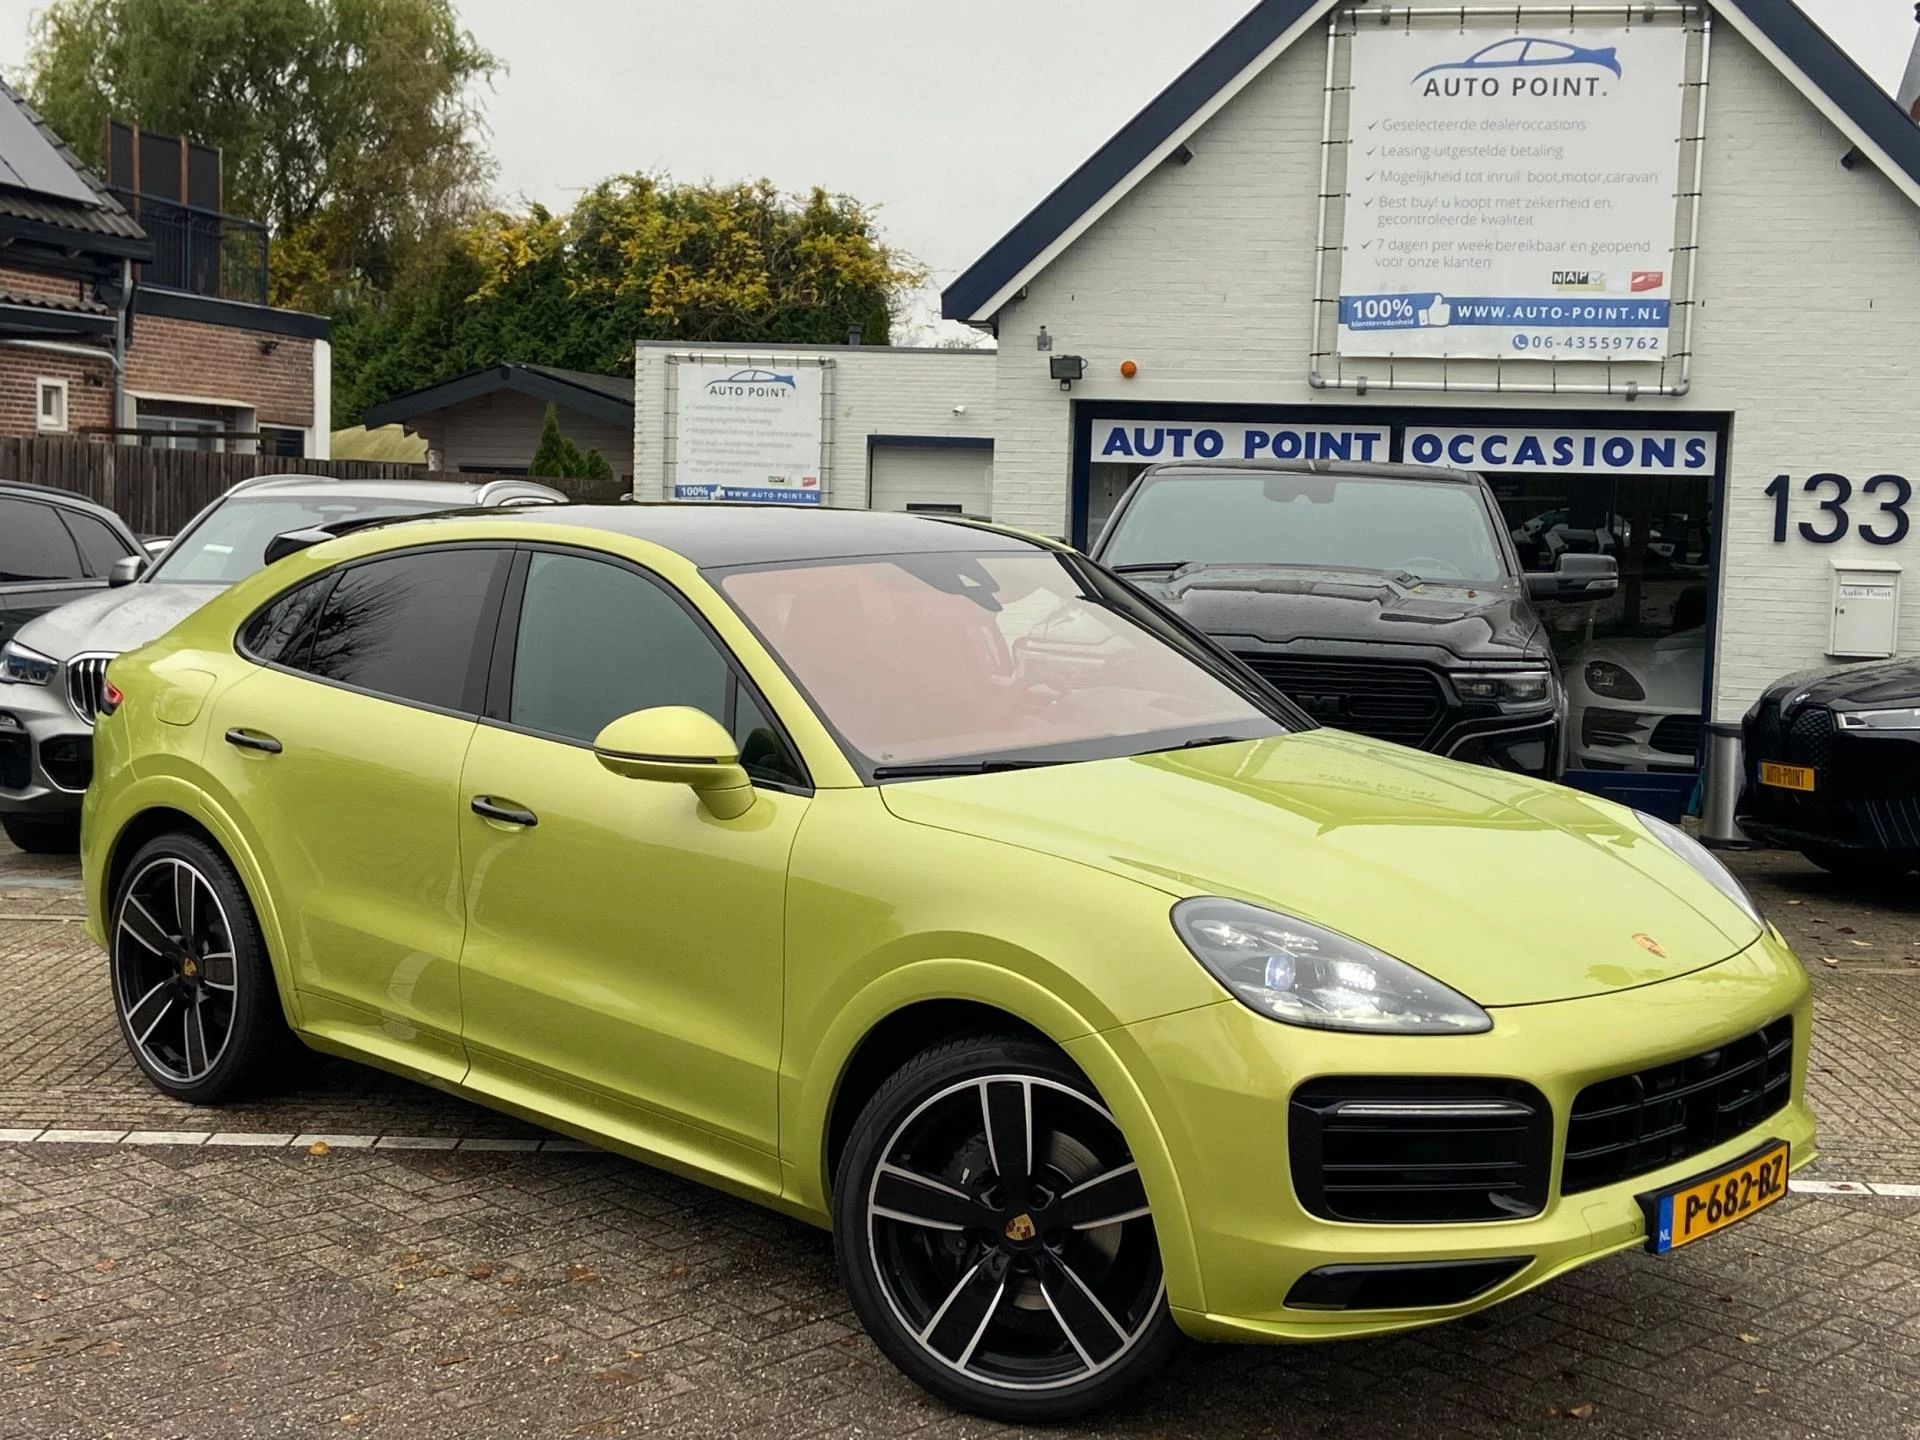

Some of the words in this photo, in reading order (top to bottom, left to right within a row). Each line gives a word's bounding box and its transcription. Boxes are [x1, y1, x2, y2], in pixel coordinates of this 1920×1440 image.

[1423, 77, 1500, 97] AUTO
[1511, 76, 1607, 97] POINT.
[1382, 118, 1477, 132] Geselecteerde
[1480, 118, 1587, 132] dealeroccasions
[1510, 144, 1564, 160] betaling
[1380, 170, 1462, 186] Mogelijkheid
[1465, 171, 1483, 183] tot
[1487, 170, 1520, 183] inruil
[1379, 196, 1407, 208] Best
[1411, 196, 1438, 211] buy!
[1442, 199, 1450, 208] u
[1454, 196, 1491, 211] koopt
[1495, 198, 1521, 208] met
[1525, 196, 1590, 208] zekerheid
[1377, 214, 1477, 228] gecontroleerde
[1481, 214, 1534, 226] kwaliteit
[1377, 239, 1385, 250] 7
[1388, 239, 1428, 254] dagen
[1432, 241, 1454, 253] per
[1458, 239, 1492, 251] week
[1495, 240, 1566, 252] bereikbaar
[1570, 242, 1587, 252] en
[1590, 241, 1651, 256] geopend
[1375, 257, 1405, 268] voor
[1408, 257, 1440, 268] onze
[1443, 256, 1492, 269] klanten
[1552, 271, 1589, 285] NAP
[1352, 298, 1413, 319] 100%
[1457, 304, 1661, 320] WWW.AUTO-POINT.NL
[1532, 335, 1659, 350] 06-43559762
[710, 386, 744, 397] AUTO
[1102, 427, 1225, 459] AUTO
[1244, 430, 1382, 461] POINT
[1411, 432, 1707, 469] OCCASIONS
[681, 486, 709, 496] 100%
[1763, 472, 1912, 546] 133
[1684, 1154, 1784, 1235] P-682-BZ
[1659, 1230, 1671, 1243] NL
